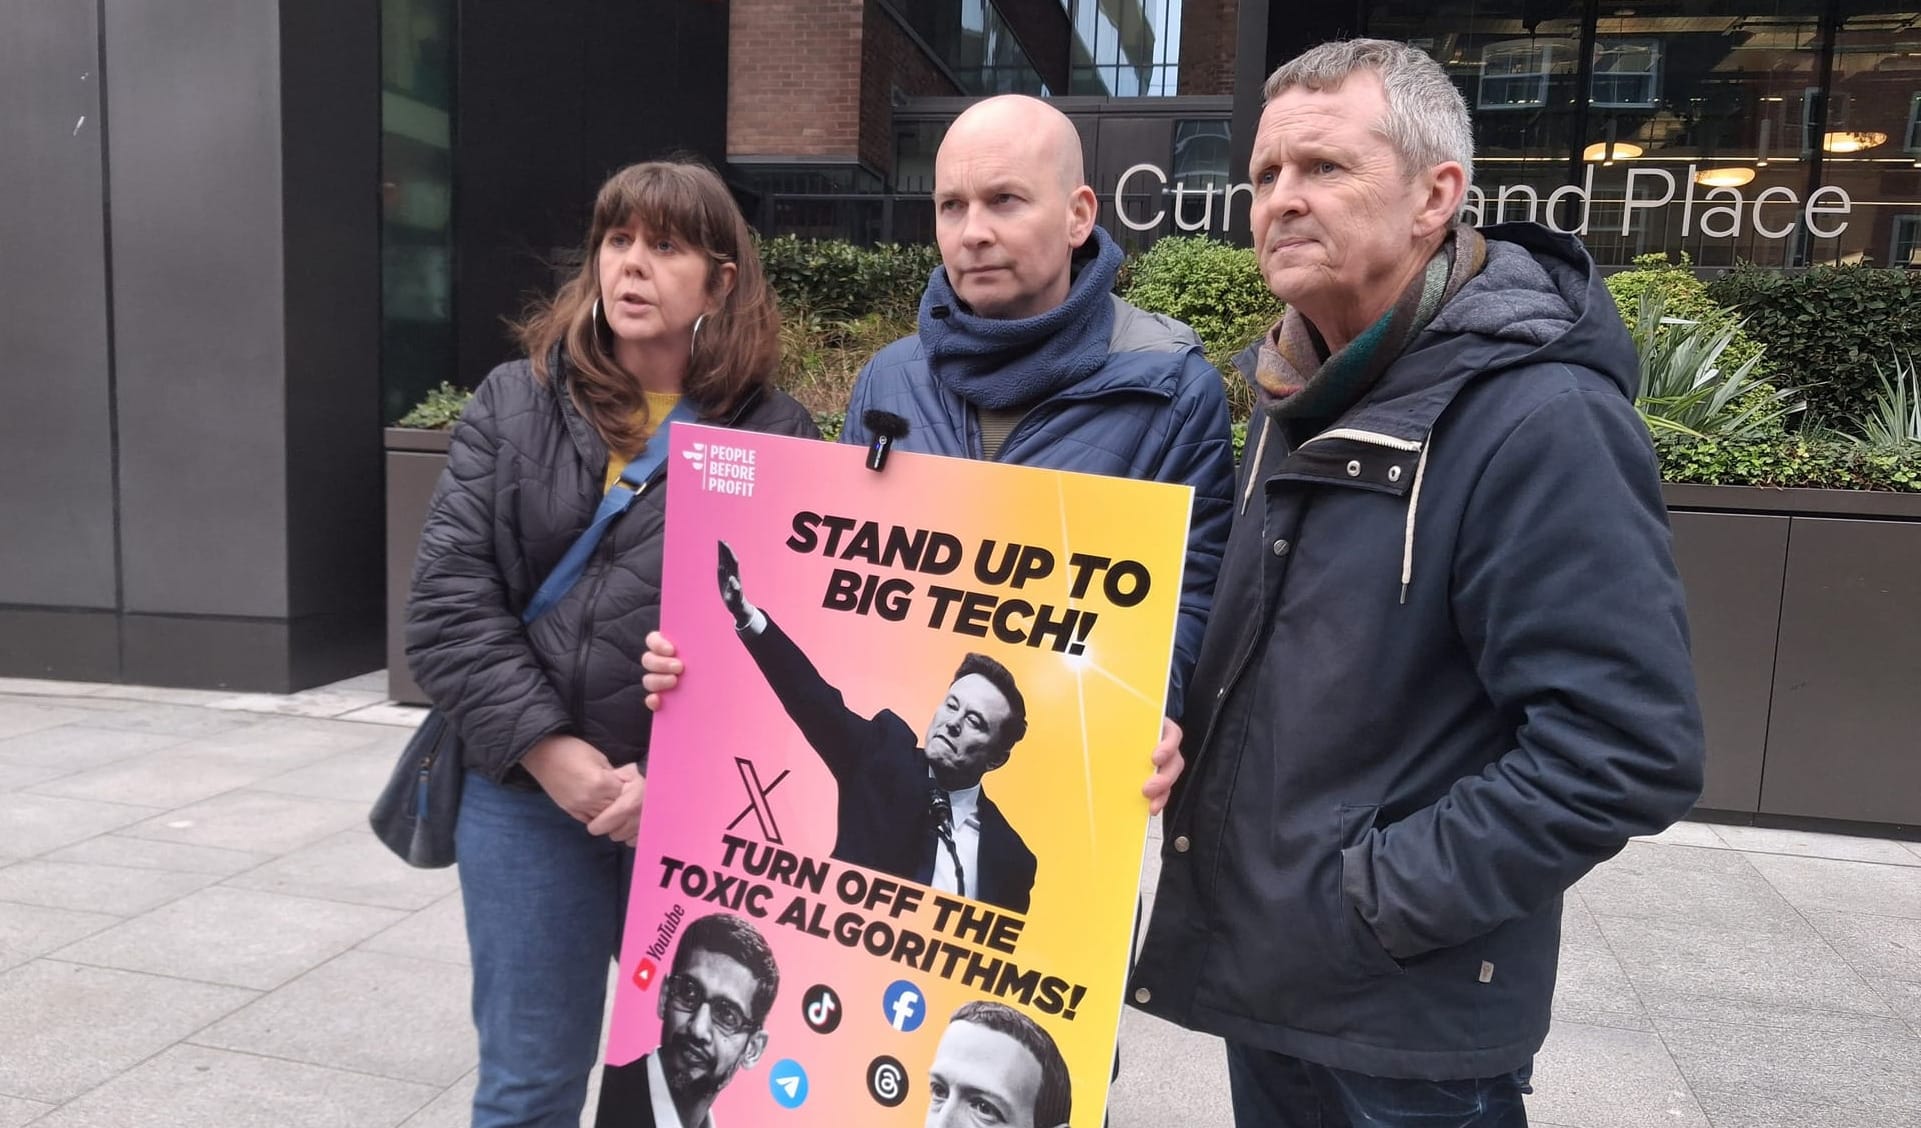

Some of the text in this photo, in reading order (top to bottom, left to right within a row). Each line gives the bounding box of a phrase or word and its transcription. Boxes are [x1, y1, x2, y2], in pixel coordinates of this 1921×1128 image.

[1621, 164, 1851, 239] Place
[708, 477, 755, 497] PROFIT
[709, 444, 757, 465] PEOPLE
[709, 461, 756, 481] BEFORE
[785, 511, 1151, 608] STAND UP TO
[822, 568, 1098, 656] BIG TECH!
[646, 903, 685, 961] YouTube
[721, 834, 1025, 955] TURN OFF THE
[659, 856, 1087, 1021] TOXIC ALGORITHMS!
